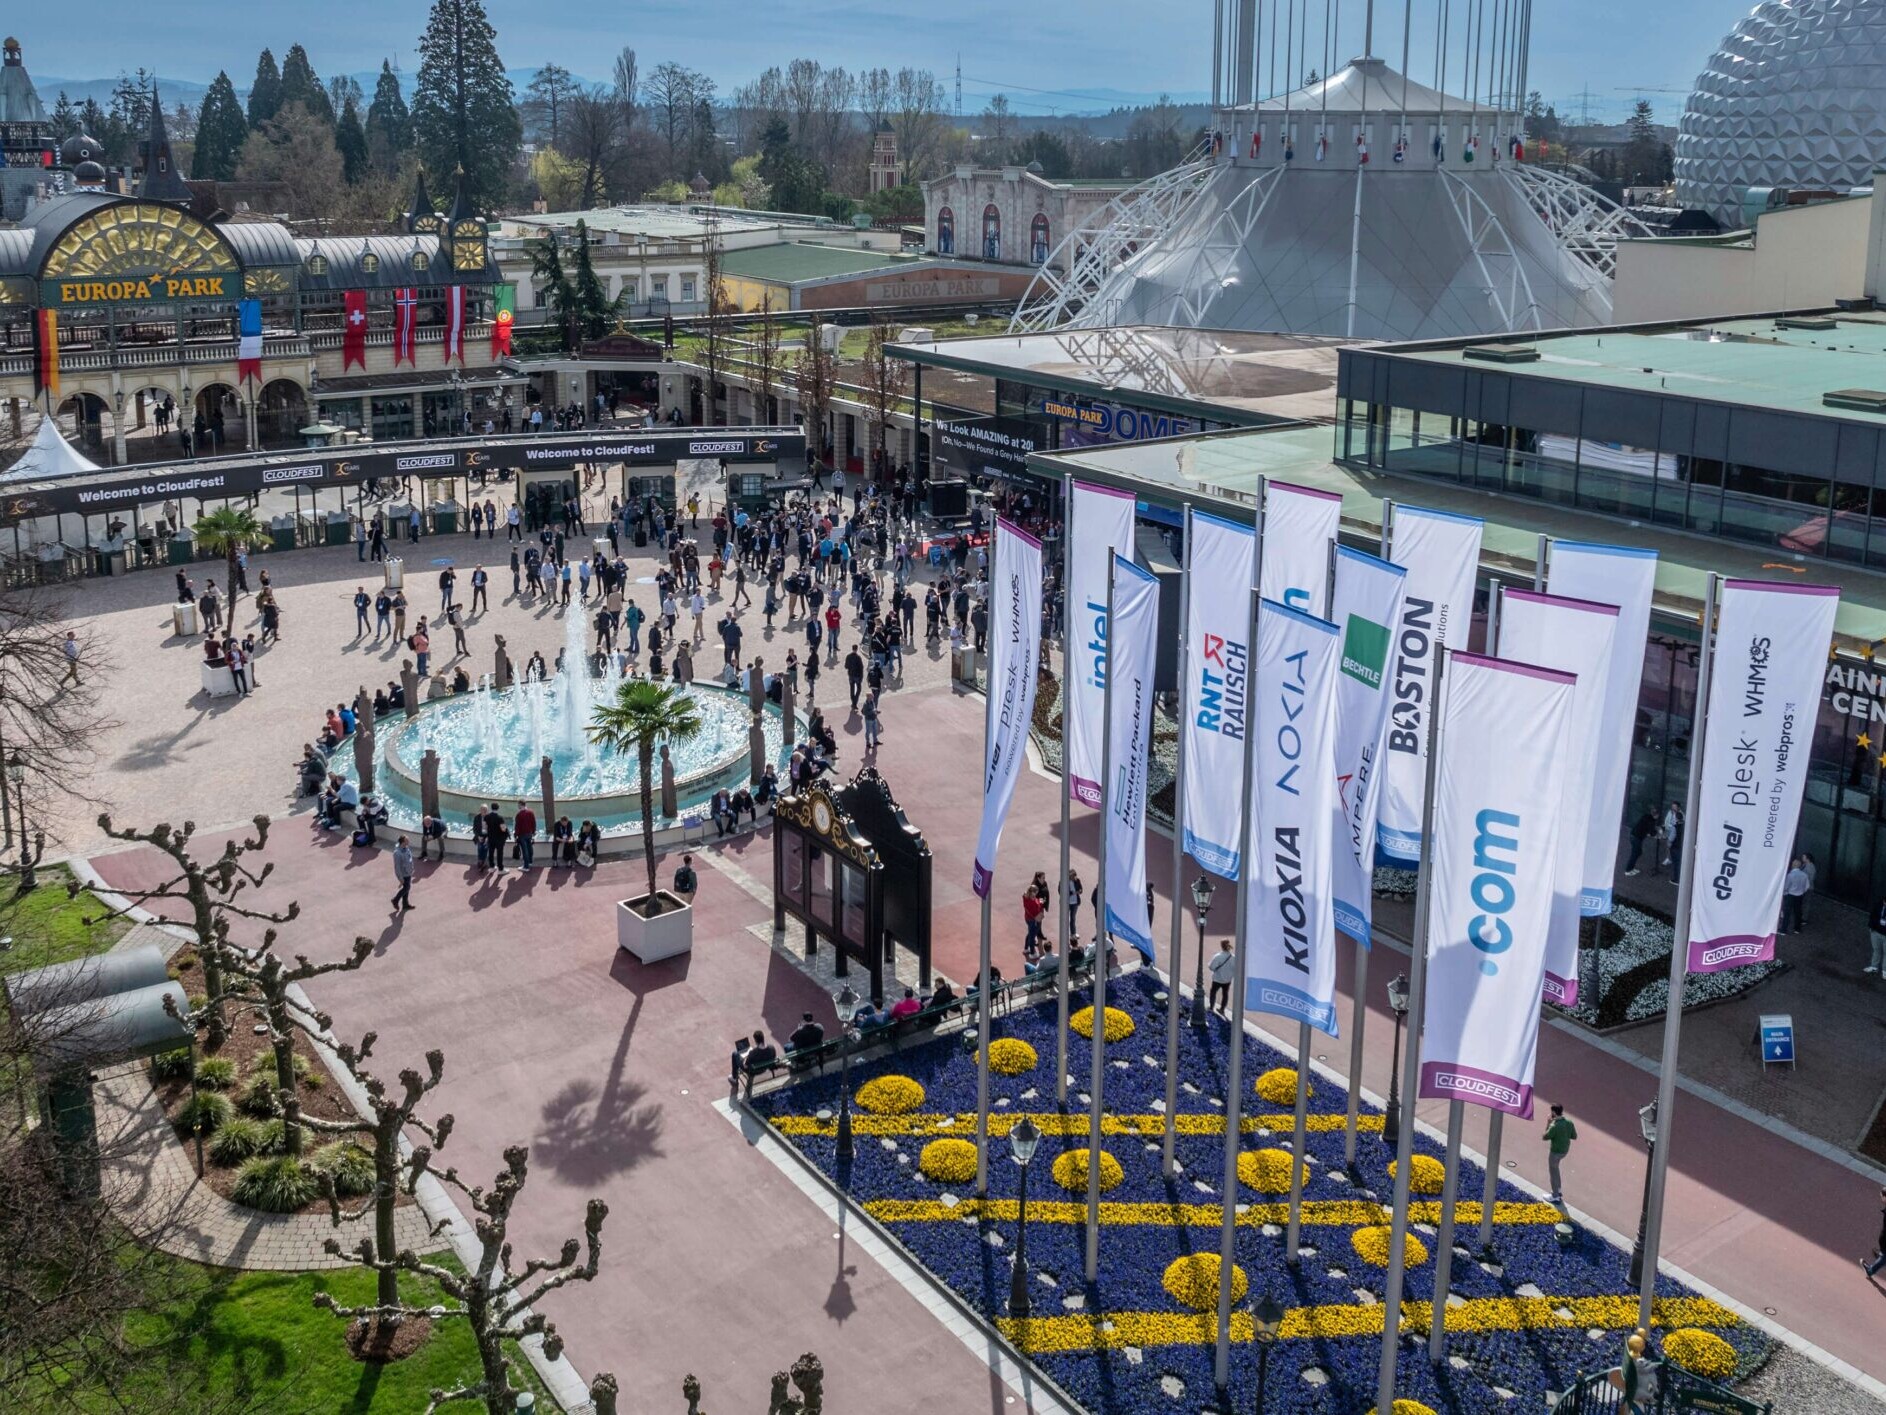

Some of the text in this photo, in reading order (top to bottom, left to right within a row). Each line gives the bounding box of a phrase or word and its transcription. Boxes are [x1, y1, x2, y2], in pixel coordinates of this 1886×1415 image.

[61, 278, 224, 302] EUROPA PARK
[882, 280, 984, 298] EUROPA PARK
[1045, 402, 1103, 424] EUROPA PARK
[1091, 402, 1190, 441] DOME
[692, 443, 742, 452] CLOUDFEST
[936, 419, 1034, 451] We Look AMAZING at 20!
[399, 456, 453, 467] CLOUDFEST
[526, 444, 655, 459] Welcome to CloudFest!
[976, 445, 994, 456] Found
[999, 449, 1013, 462] Grey
[79, 475, 225, 503] Welcome to CloudFest!
[265, 467, 319, 480] CLOUDFEST
[1087, 601, 1107, 689] intel
[1342, 656, 1380, 684] BECHTLE
[1389, 596, 1434, 755] BOSTON
[1197, 667, 1223, 732] RNT
[1222, 640, 1246, 741] RAUSCH
[1276, 650, 1308, 796] NOKIA
[1122, 678, 1142, 826] Hewlett Packard
[1713, 637, 1771, 901] cPanel plesk WHMCS
[1763, 714, 1794, 848] powered by webpros
[1353, 746, 1373, 869] AMPERE
[1275, 827, 1309, 975] KIOXIA
[1468, 808, 1520, 977] .com
[1705, 945, 1759, 963] CLOUDFEST
[1439, 1075, 1517, 1103] CLOUDFEST
